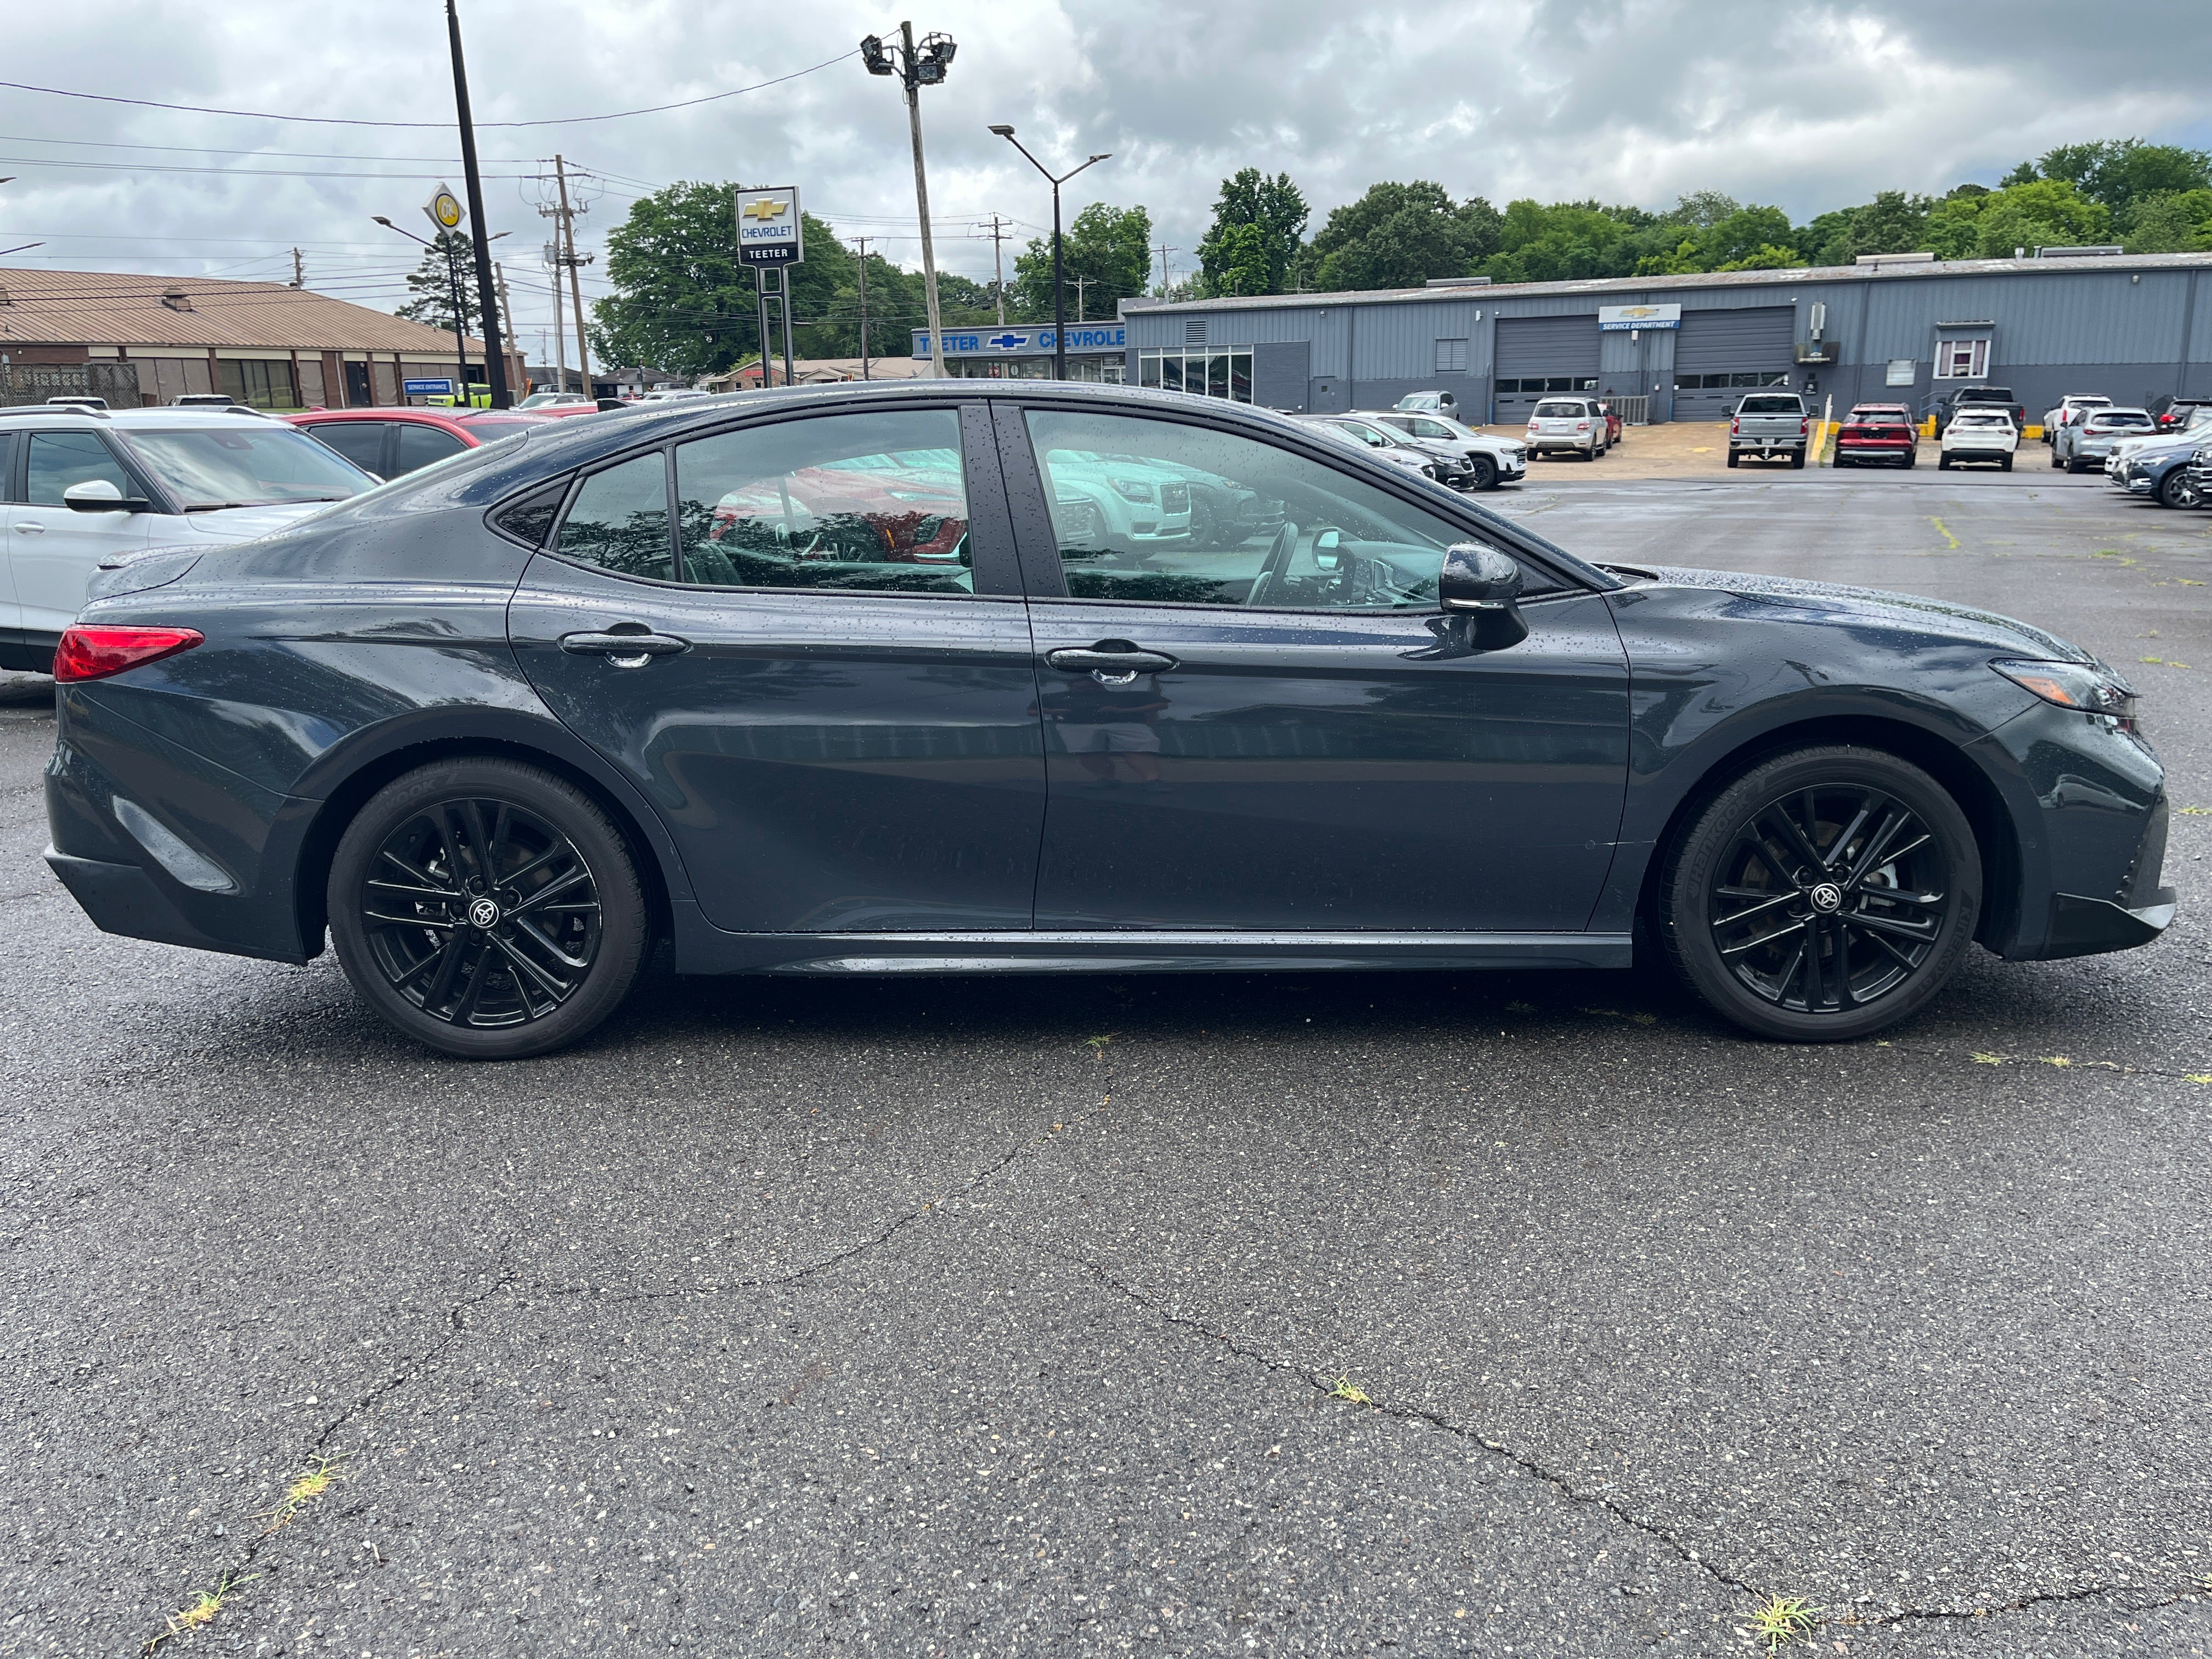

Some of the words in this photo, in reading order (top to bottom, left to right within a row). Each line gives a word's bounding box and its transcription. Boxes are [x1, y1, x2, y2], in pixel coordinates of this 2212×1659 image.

[441, 200, 456, 219] OK
[742, 225, 792, 238] CHEVROLET
[749, 249, 788, 259] TEETER
[1631, 320, 1676, 329] DEPARTMENT
[919, 336, 979, 352] TETER
[1039, 330, 1125, 347] CHEVROLE
